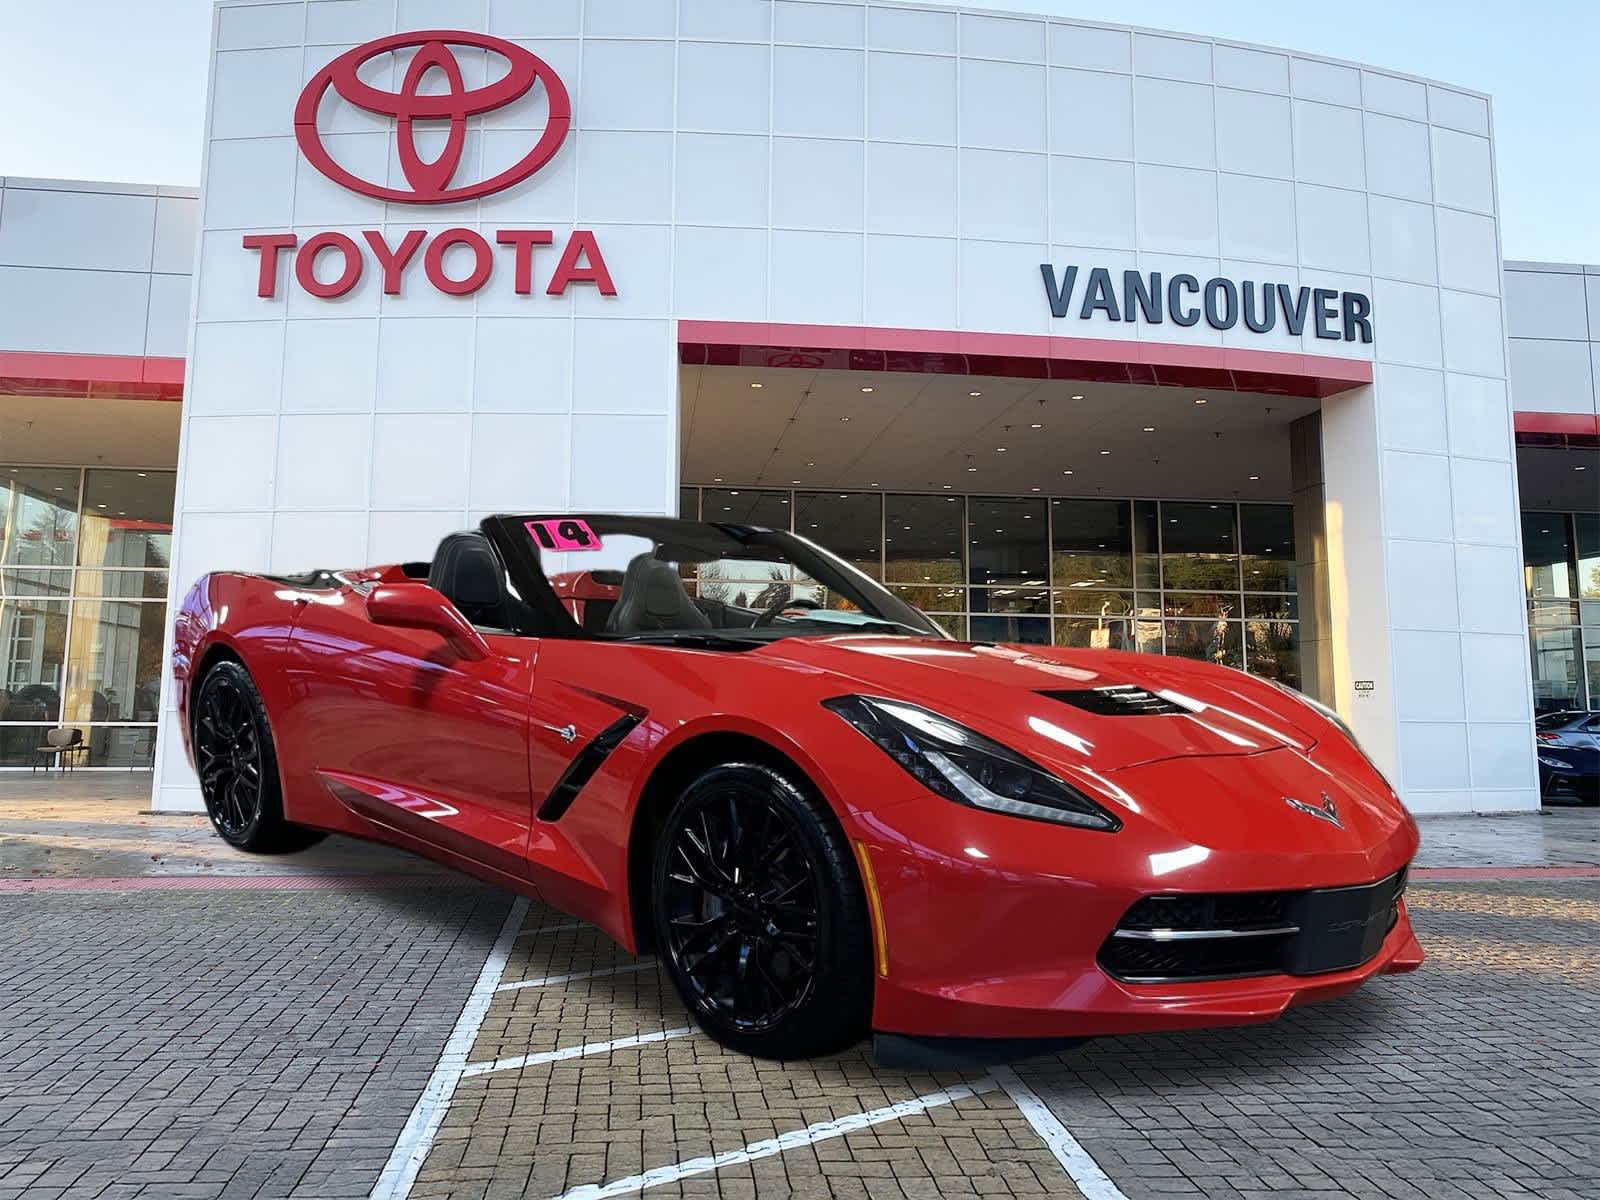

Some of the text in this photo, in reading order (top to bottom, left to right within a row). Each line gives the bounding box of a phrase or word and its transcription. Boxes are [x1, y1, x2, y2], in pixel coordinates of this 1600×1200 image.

[243, 228, 617, 298] TOYOTA
[1040, 264, 1373, 343] VANCOUVER
[531, 521, 591, 549] 14
